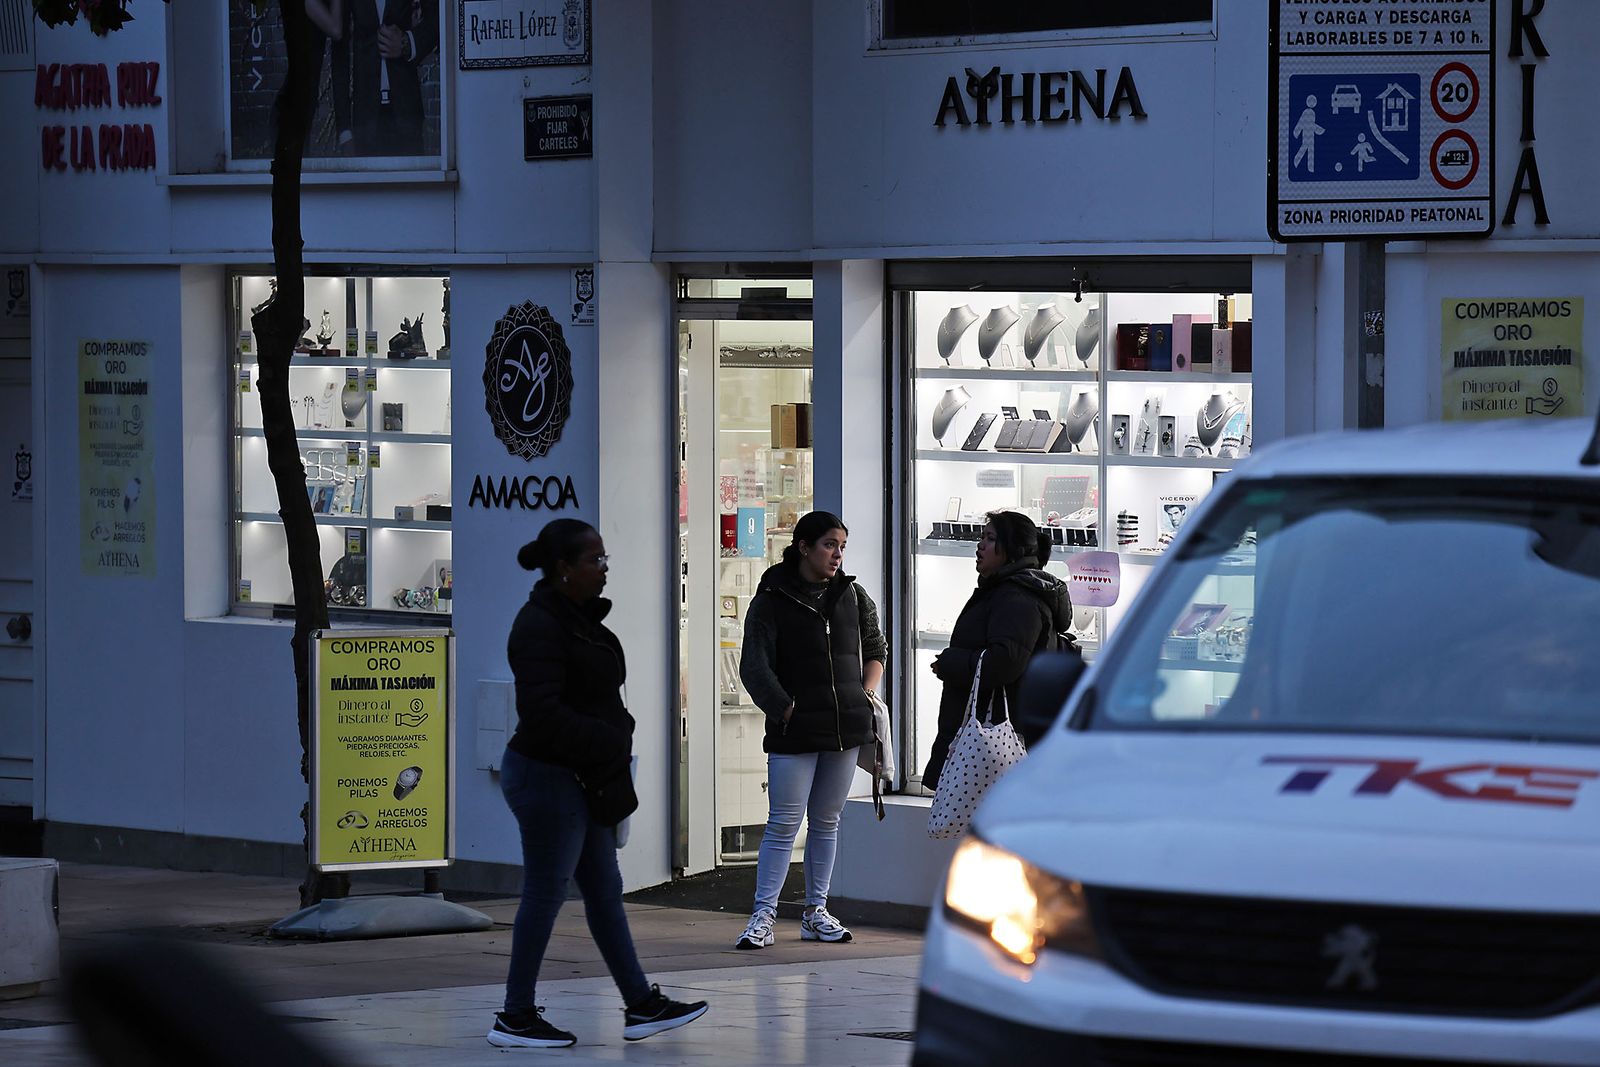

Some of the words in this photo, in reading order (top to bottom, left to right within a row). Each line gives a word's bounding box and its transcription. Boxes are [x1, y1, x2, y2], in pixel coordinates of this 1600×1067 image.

[1299, 12, 1308, 25] Y
[1314, 11, 1368, 25] CARGA
[1374, 11, 1383, 25] Y
[1389, 10, 1472, 24] DESCARGA
[471, 14, 514, 45] RAFAEL
[520, 10, 557, 40] LÓPEZ
[1287, 31, 1387, 46] LABORABLES
[1393, 31, 1413, 45] DE
[1419, 31, 1428, 45] 7
[1433, 31, 1443, 45] A
[1450, 30, 1465, 45] 10
[1471, 31, 1483, 44] h.
[35, 63, 111, 110] AGATHA
[117, 62, 161, 108] RUIZ
[1441, 83, 1469, 103] 20
[537, 104, 578, 119] PROHIBIDO
[547, 121, 568, 134] FIJAR
[42, 125, 67, 170] DE
[70, 125, 96, 170] LA
[99, 124, 156, 171] PRADA
[539, 137, 578, 150] CARTELES
[1284, 210, 1323, 224] ZONA
[1330, 208, 1405, 223] PRIORIDAD
[1411, 207, 1483, 222] PEATONAL
[1455, 301, 1571, 319] COMPRAMOS
[1494, 324, 1532, 341] ORO
[85, 342, 147, 356] COMPRAMOS
[1454, 347, 1506, 368] MÁXIMA
[1509, 345, 1571, 366] TASACIÓN
[105, 361, 126, 374] ORO
[1462, 379, 1505, 393] Dinero
[1509, 380, 1520, 392] al
[1462, 397, 1518, 411] instante
[468, 474, 579, 510] AMAGOA
[331, 640, 435, 654] COMPRAMOS
[367, 658, 401, 671] ORO
[331, 675, 378, 690] MÁXIMA
[381, 673, 435, 690] TASACIÓN
[338, 700, 378, 711] Dinero
[380, 700, 390, 710] al
[338, 713, 389, 724] instante
[338, 735, 384, 743] VALORAMOS
[337, 778, 388, 788] PONEMOS
[350, 789, 378, 798] PILAS
[378, 808, 428, 817] HACEMOS
[375, 819, 428, 829] ARREGLOS
